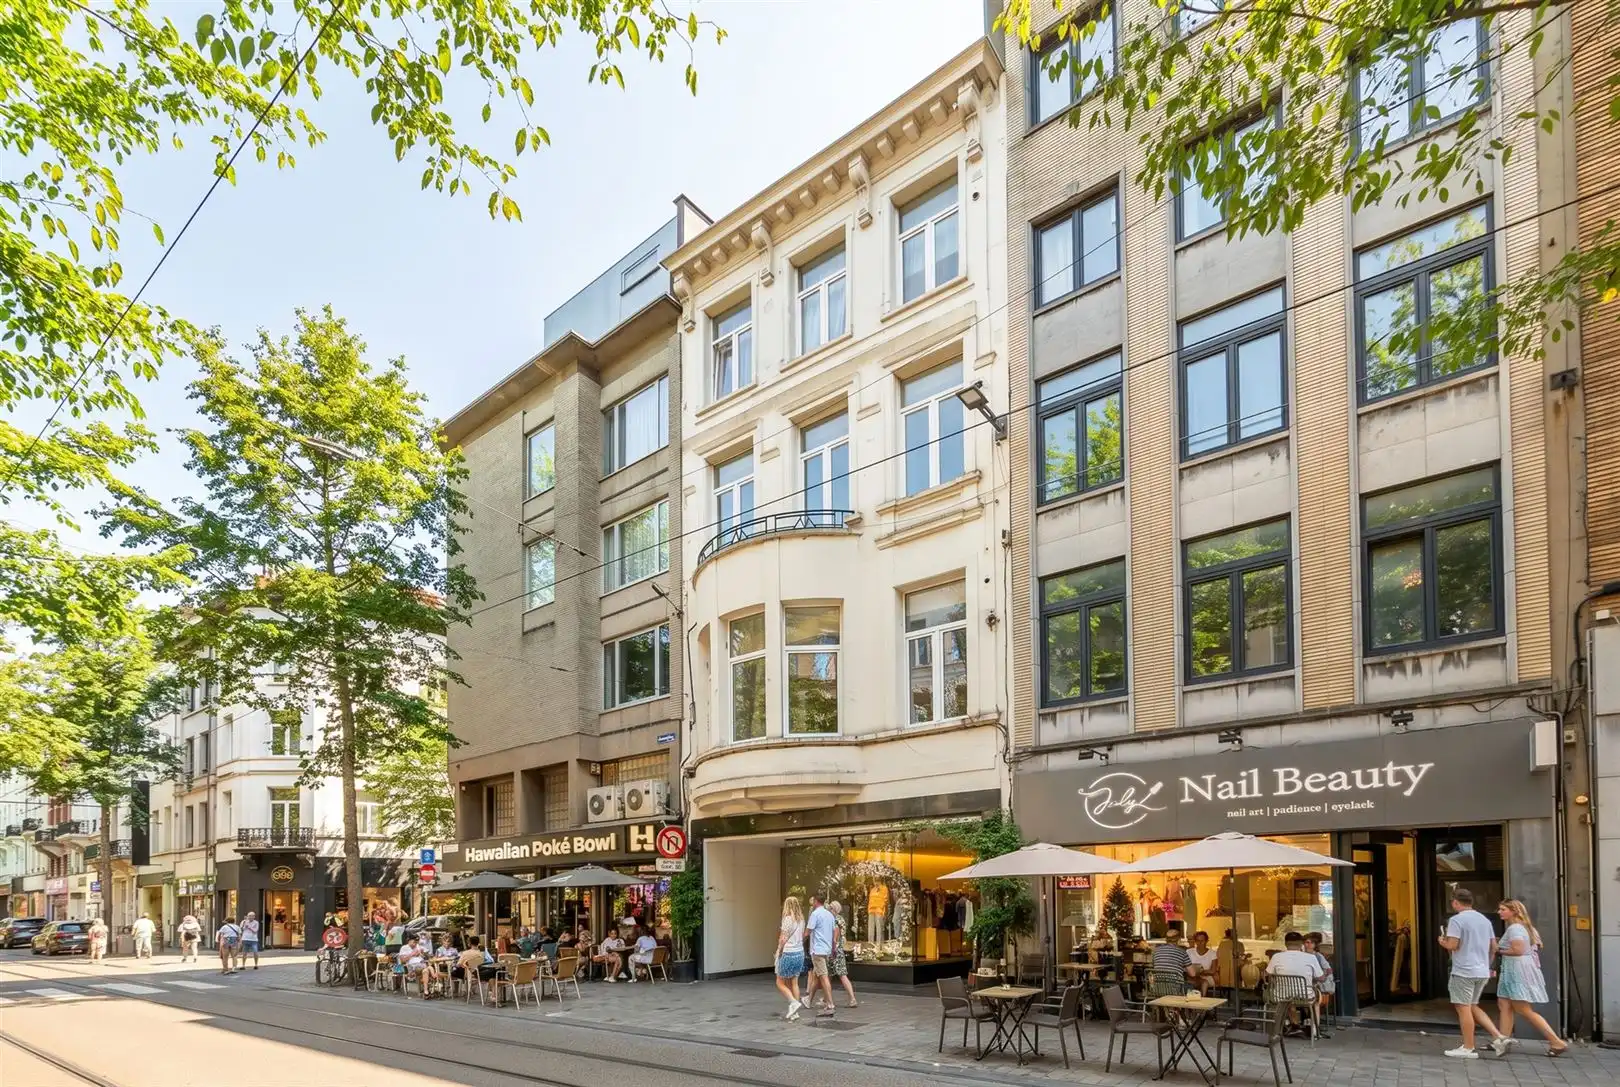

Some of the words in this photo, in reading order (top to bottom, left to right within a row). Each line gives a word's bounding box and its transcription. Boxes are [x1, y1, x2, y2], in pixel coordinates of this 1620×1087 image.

[1179, 768, 1263, 804] Nail
[1272, 760, 1435, 797] Beauty
[1248, 808, 1264, 817] art
[532, 836, 571, 857] Poké
[573, 832, 617, 854] Bowl
